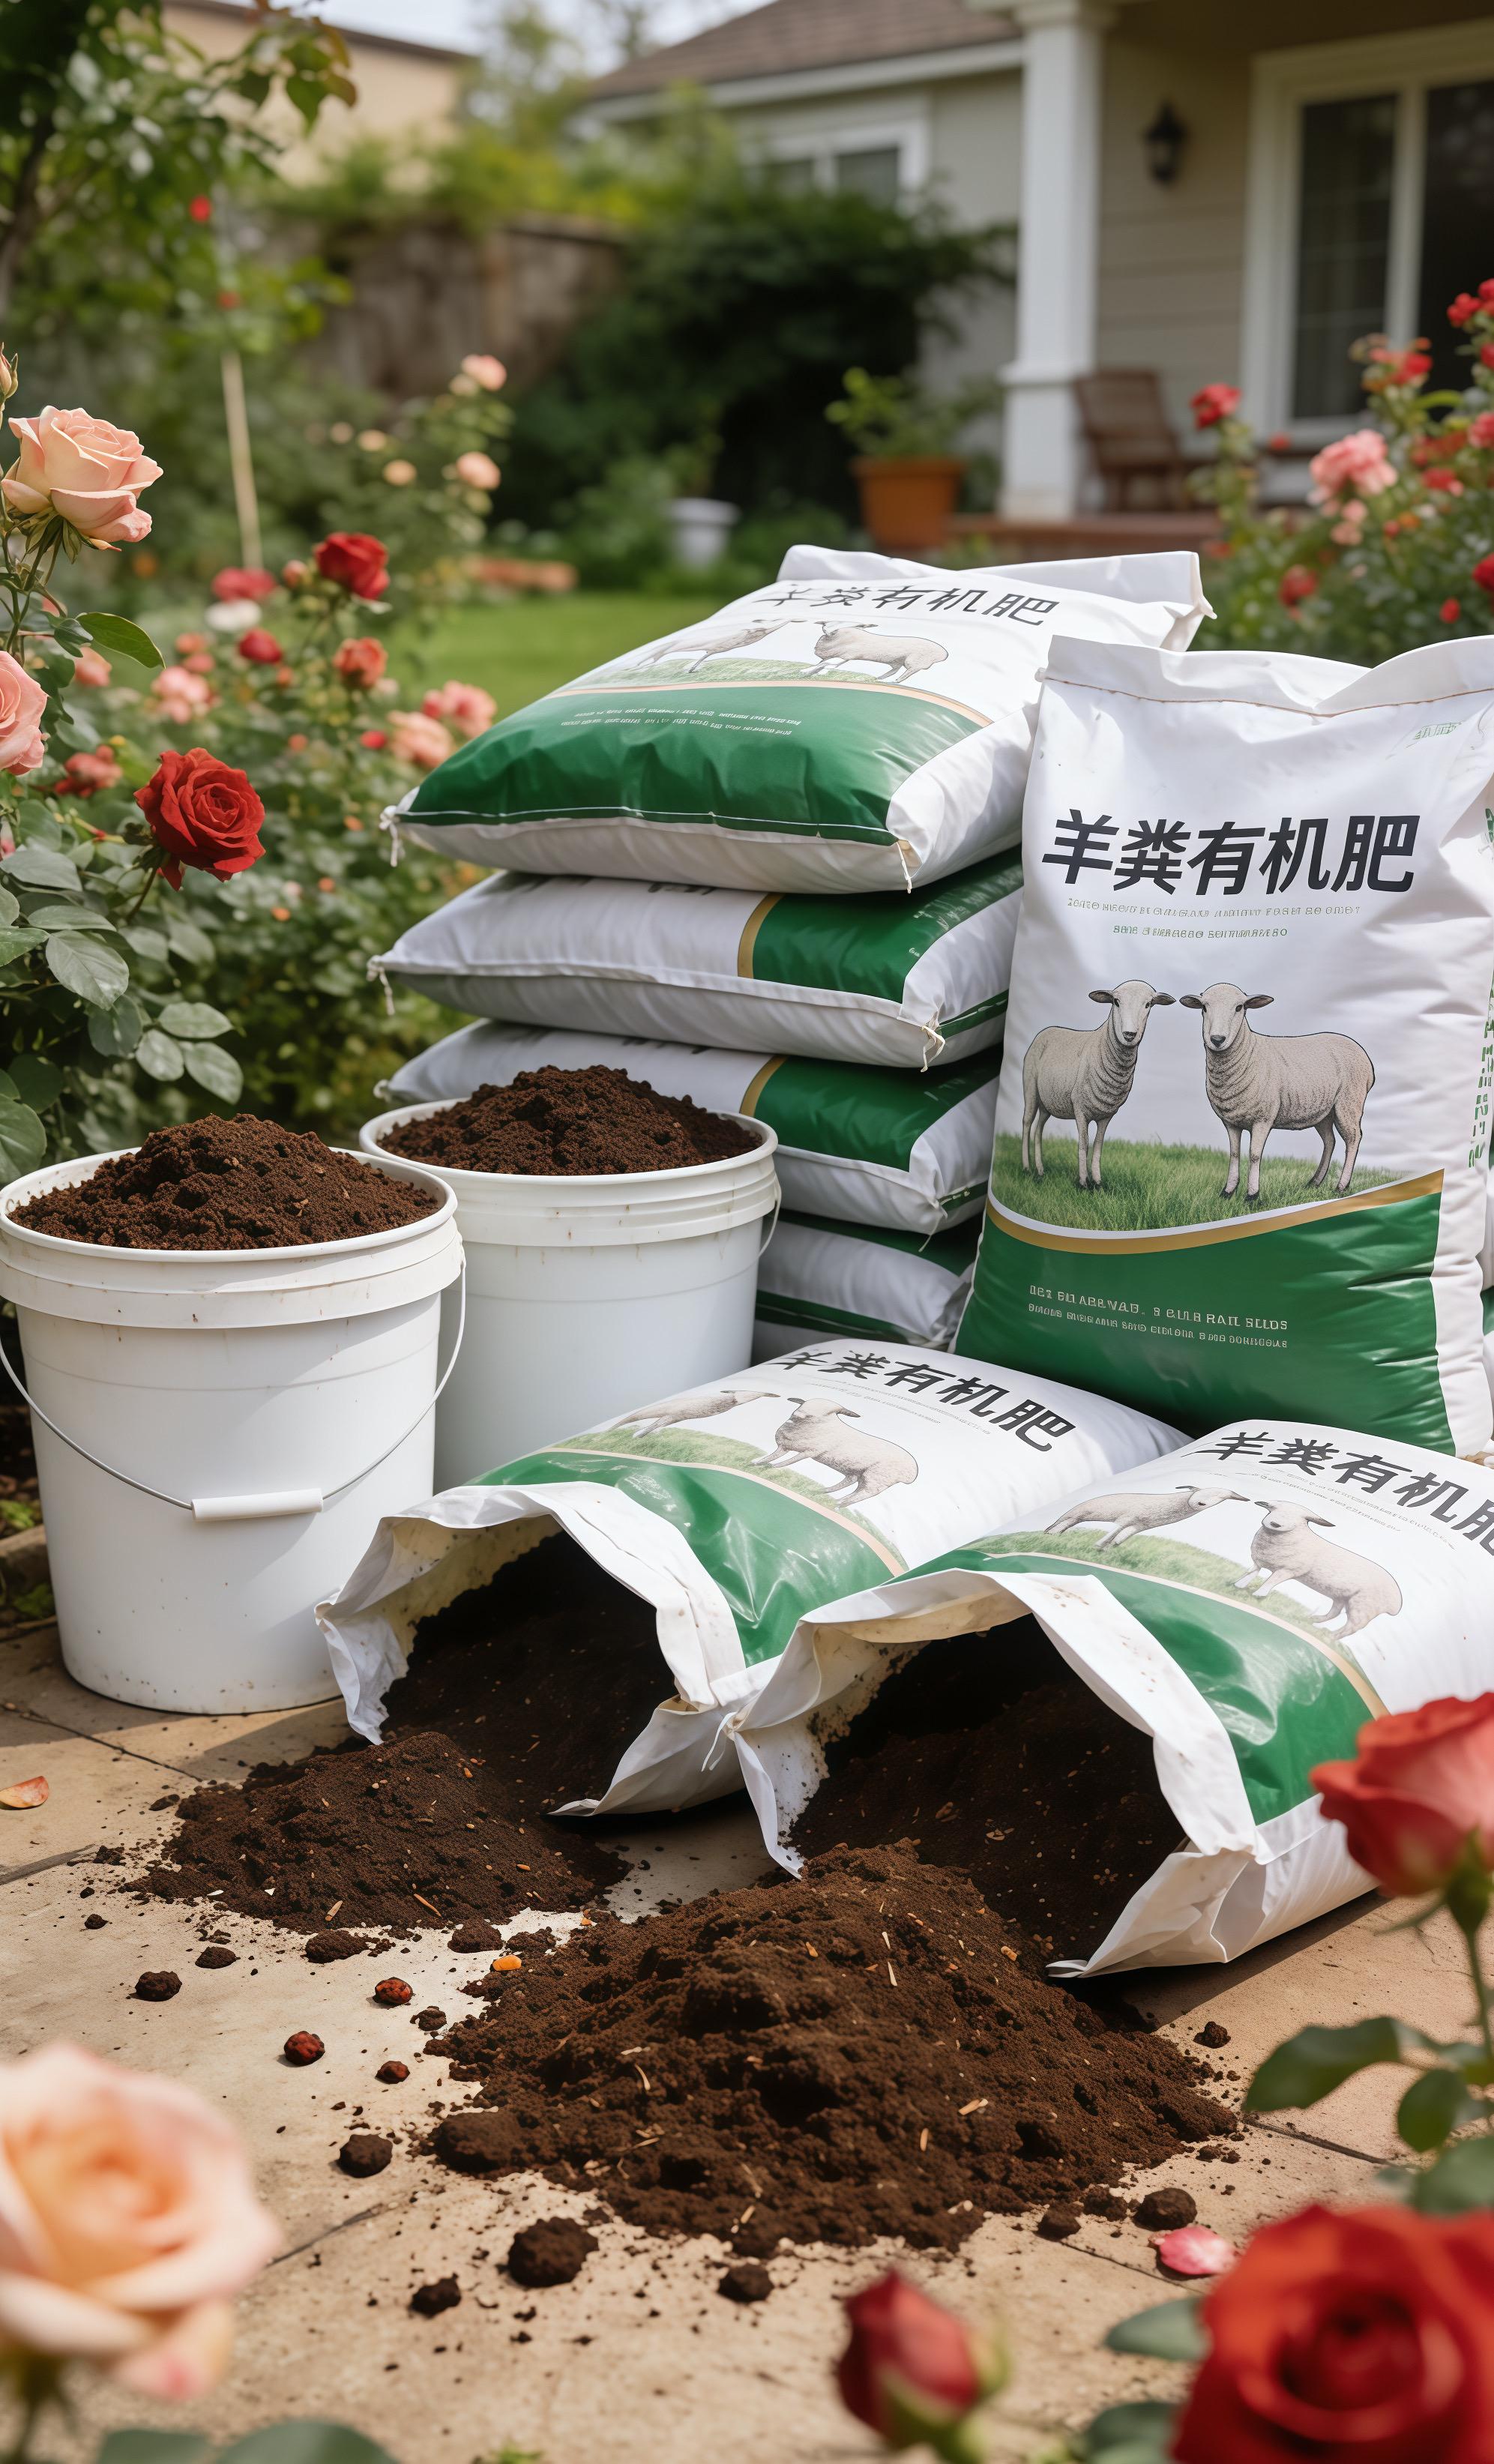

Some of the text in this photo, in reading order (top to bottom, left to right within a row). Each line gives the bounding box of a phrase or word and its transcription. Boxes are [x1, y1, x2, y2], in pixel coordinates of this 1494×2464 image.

[1041, 809, 1421, 896] 羊粪有机肥
